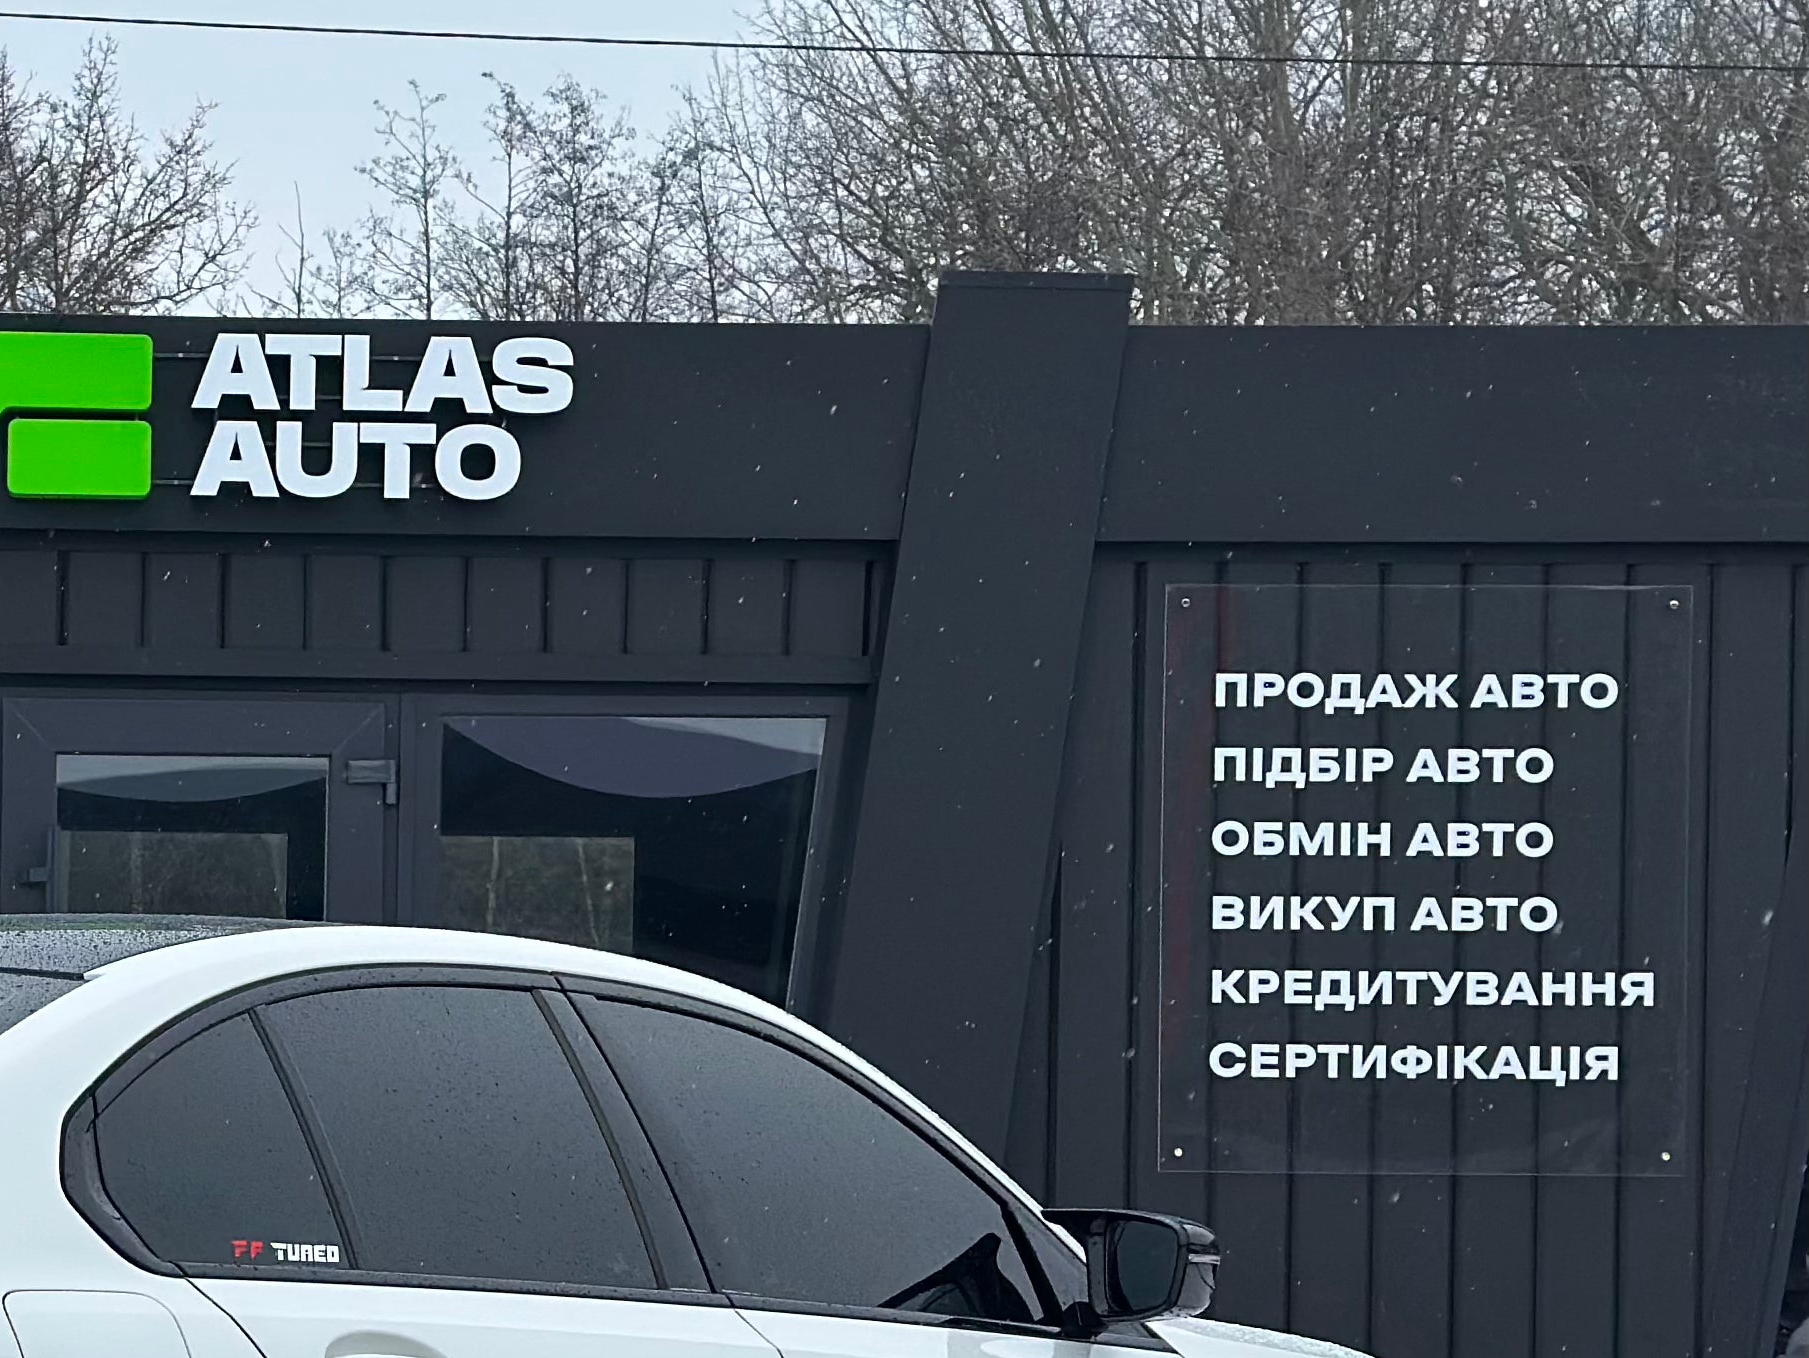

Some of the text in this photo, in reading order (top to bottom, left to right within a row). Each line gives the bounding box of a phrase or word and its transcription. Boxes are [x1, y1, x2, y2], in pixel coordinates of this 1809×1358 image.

[191, 333, 574, 413] ATLAS
[190, 421, 522, 500] AUTO
[1215, 672, 1619, 715] ПРОДАЖ АВТО
[1213, 747, 1554, 789] ПІДБІР АВТО
[1211, 820, 1554, 858] ОБМІН АВТО
[1212, 895, 1558, 932] ВИКУП АВТО
[1211, 969, 1655, 1012] КРЕДИТУВАННЯ
[1208, 1042, 1619, 1087] СЕРТИФІКАЦІЯ
